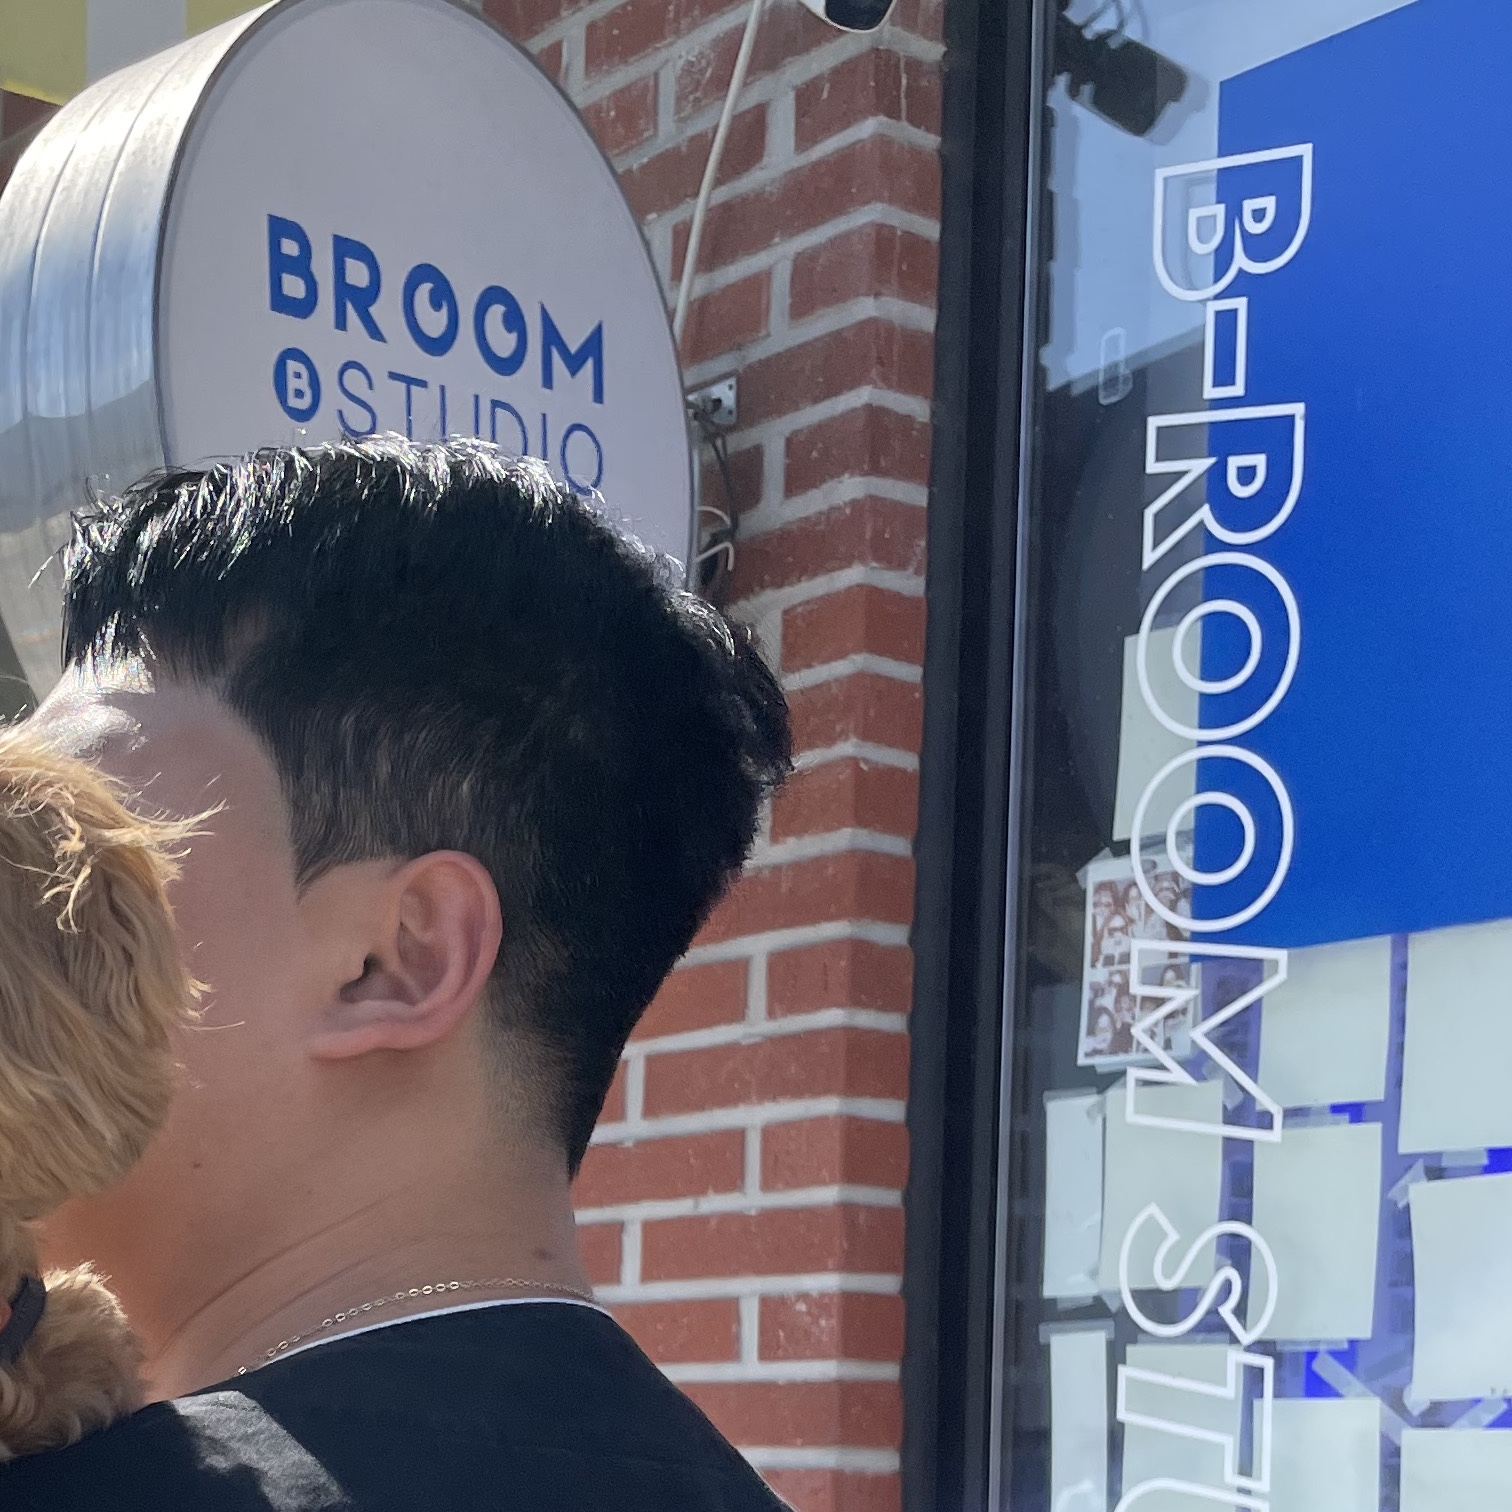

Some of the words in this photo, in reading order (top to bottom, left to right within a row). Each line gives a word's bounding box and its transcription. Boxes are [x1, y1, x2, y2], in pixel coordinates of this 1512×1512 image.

[267, 213, 604, 405] BROOM
[337, 360, 604, 496] STUDIO
[1124, 142, 1315, 1143] B-ROOM
